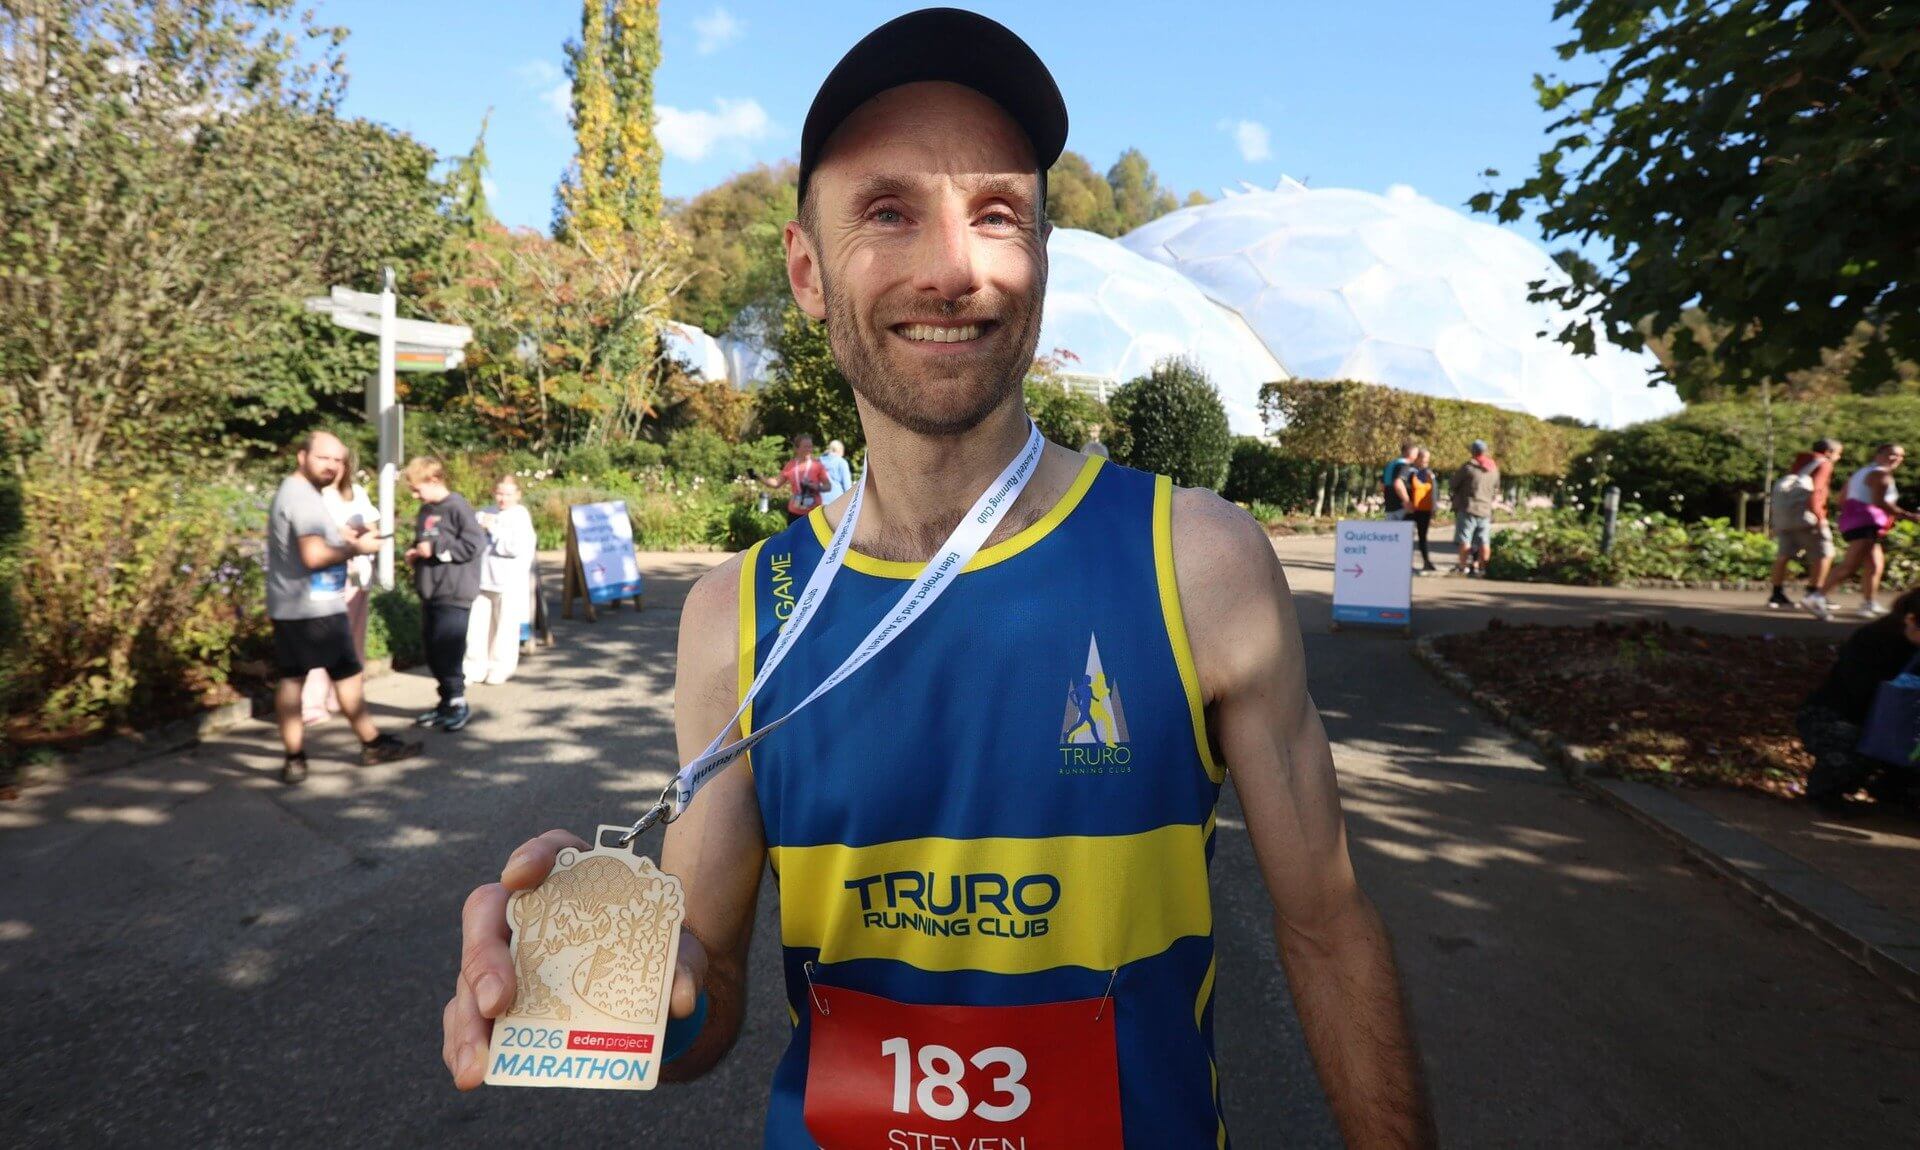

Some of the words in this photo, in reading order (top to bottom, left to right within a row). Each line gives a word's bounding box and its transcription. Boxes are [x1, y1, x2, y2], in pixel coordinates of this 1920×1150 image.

[1017, 452, 1034, 479] Austell
[989, 476, 1019, 508] Running
[977, 506, 995, 524] Club
[1344, 530, 1399, 542] Quickest
[938, 551, 961, 572] Eden
[1344, 545, 1367, 555] exit
[916, 572, 944, 599] Project
[894, 614, 907, 624] St
[901, 599, 920, 615] and
[866, 623, 897, 651] Austell
[1059, 746, 1131, 766] TRURO
[844, 870, 1061, 916] TRURO
[863, 911, 971, 938] RUNNING
[977, 917, 1049, 939] CLUB
[501, 1026, 563, 1049] 2026
[573, 1034, 605, 1046] eden
[605, 1036, 649, 1050] project
[491, 1053, 650, 1082] MARATHON
[881, 1036, 1032, 1122] 183
